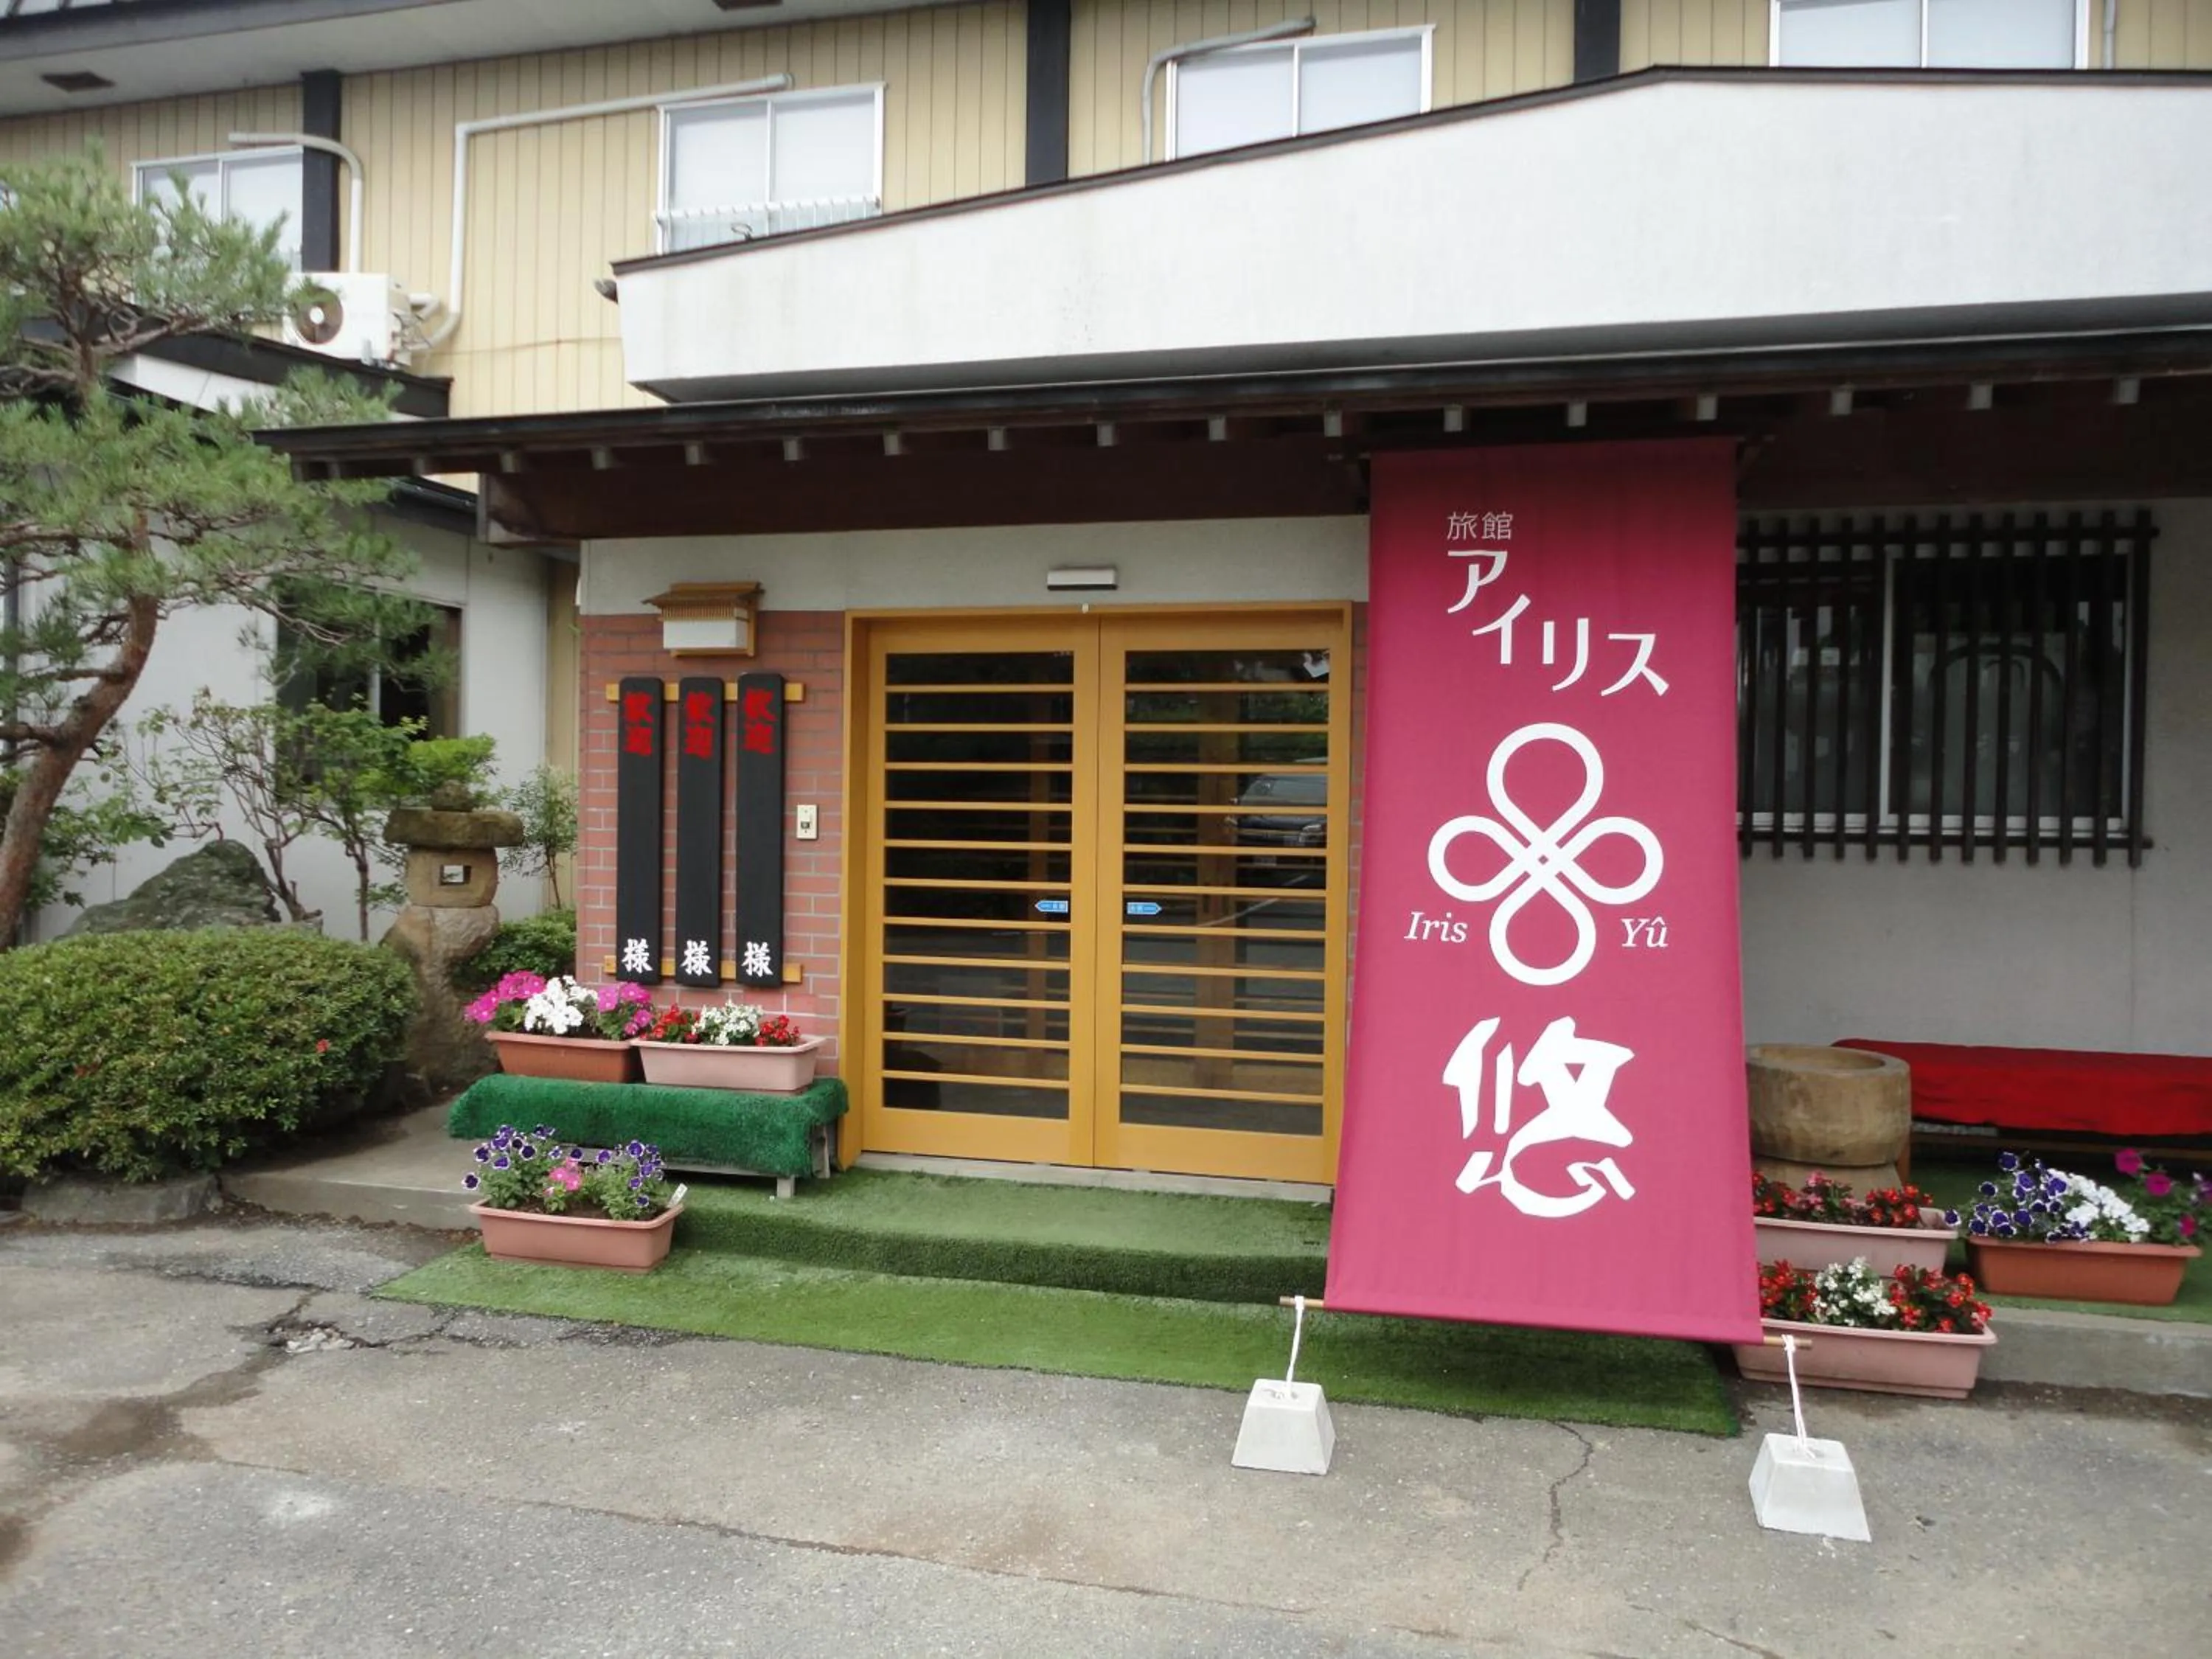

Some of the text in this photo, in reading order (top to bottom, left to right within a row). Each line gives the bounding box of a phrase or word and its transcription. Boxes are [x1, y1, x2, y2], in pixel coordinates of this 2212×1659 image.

[1447, 512, 1513, 540] 旅館
[1447, 549, 1669, 697] アイリス
[1403, 911, 1669, 948] Iris Yû
[621, 938, 653, 974] 様
[681, 939, 714, 977] 様
[741, 941, 774, 978] 様
[1441, 1015, 1637, 1219] 悠
